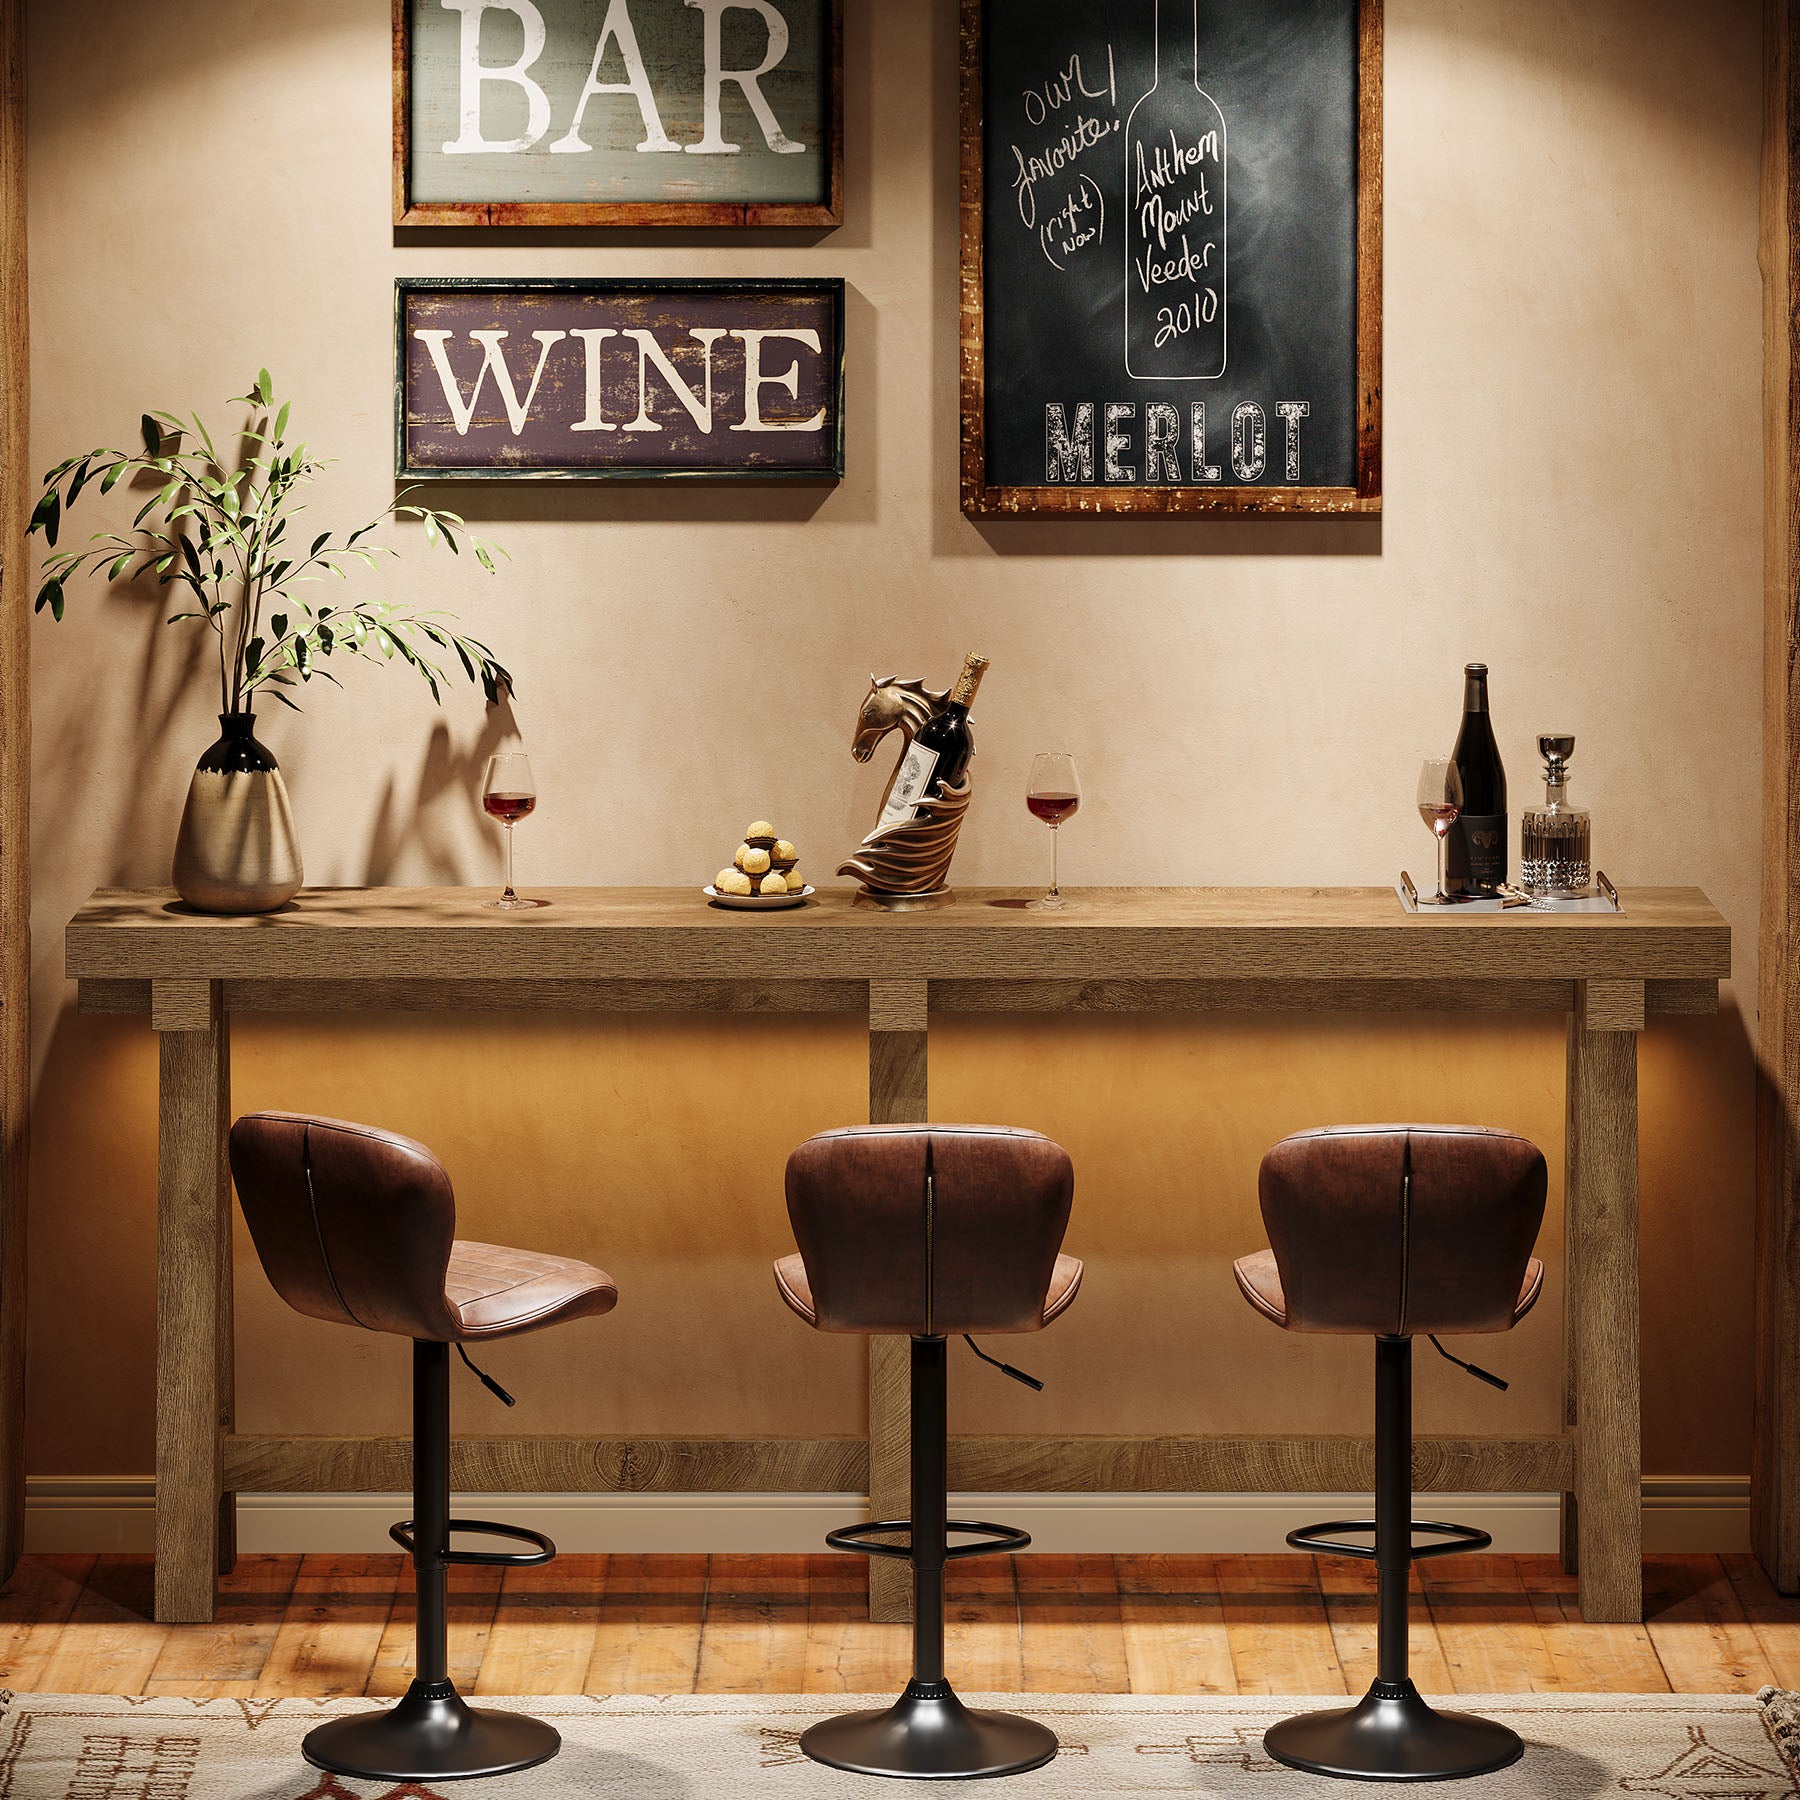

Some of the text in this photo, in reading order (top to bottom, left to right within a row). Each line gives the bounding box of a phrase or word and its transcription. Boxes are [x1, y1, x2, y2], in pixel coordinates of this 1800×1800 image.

[440, 0, 806, 154] BAR
[1135, 234, 1216, 293] Veeder
[1154, 287, 1218, 349] 2010
[413, 328, 827, 435] WINE
[1046, 401, 1310, 482] MERLOT
